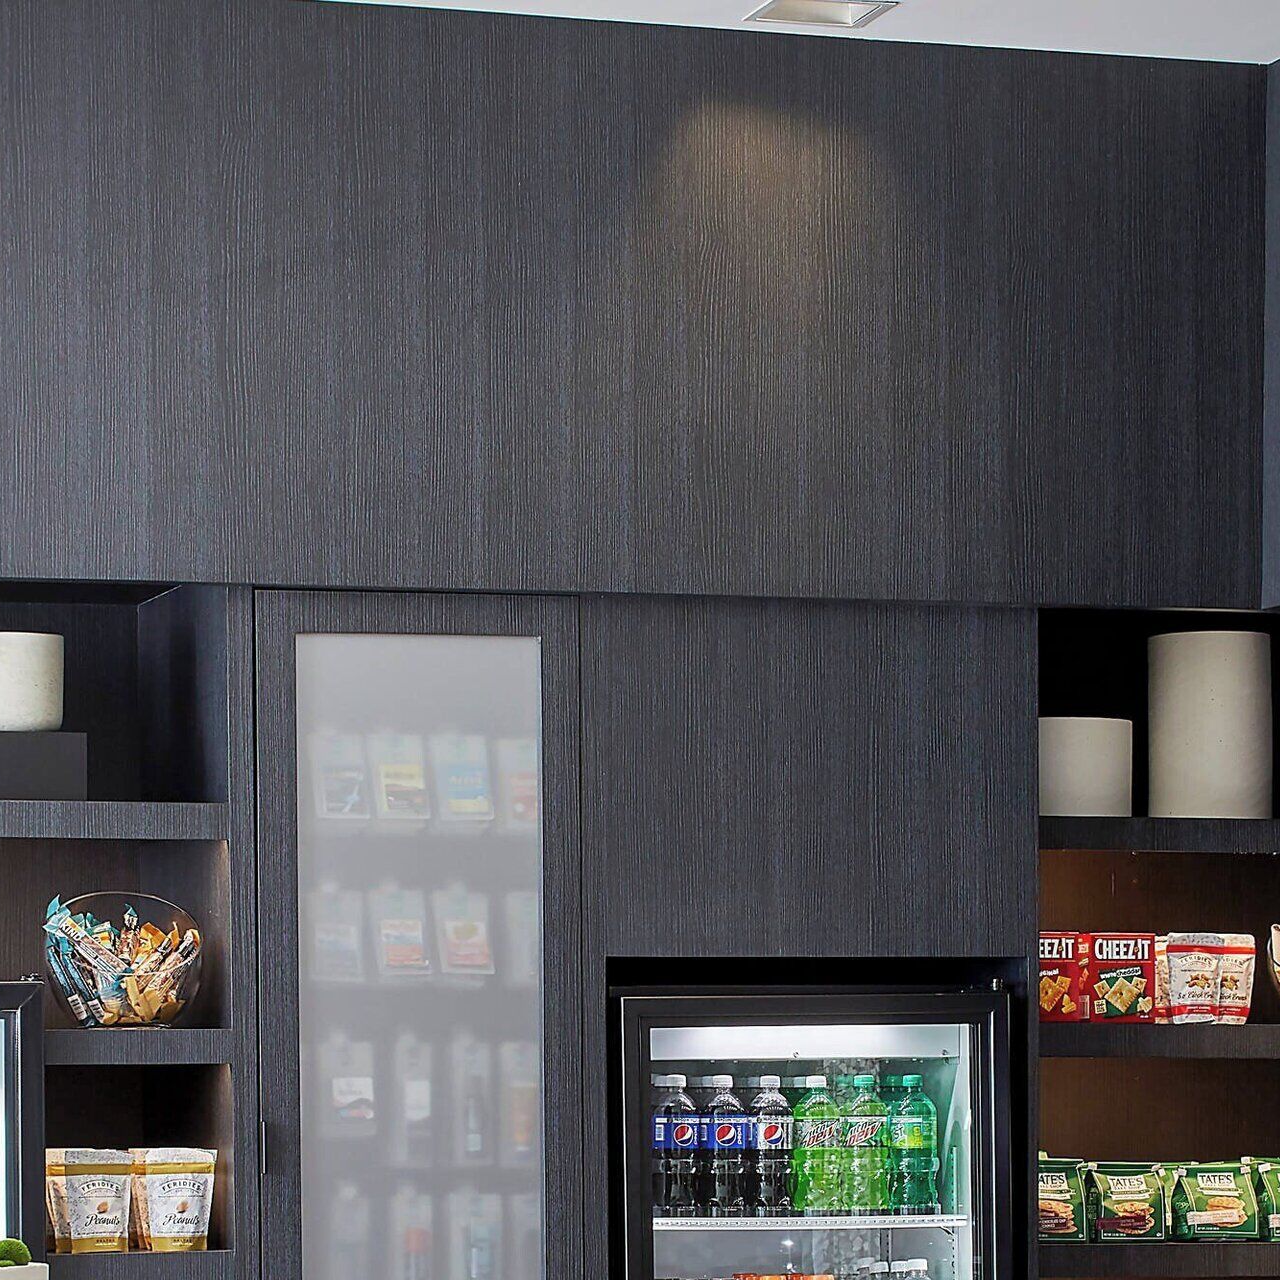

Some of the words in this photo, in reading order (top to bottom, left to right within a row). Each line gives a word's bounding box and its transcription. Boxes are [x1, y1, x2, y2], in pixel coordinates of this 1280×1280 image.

[60, 922, 83, 941] KIND
[1109, 1178, 1143, 1187] TATE'S
[1200, 1175, 1232, 1184] TATE'S
[81, 1180, 121, 1192] FERIDIES
[85, 1214, 121, 1227] Peanuts
